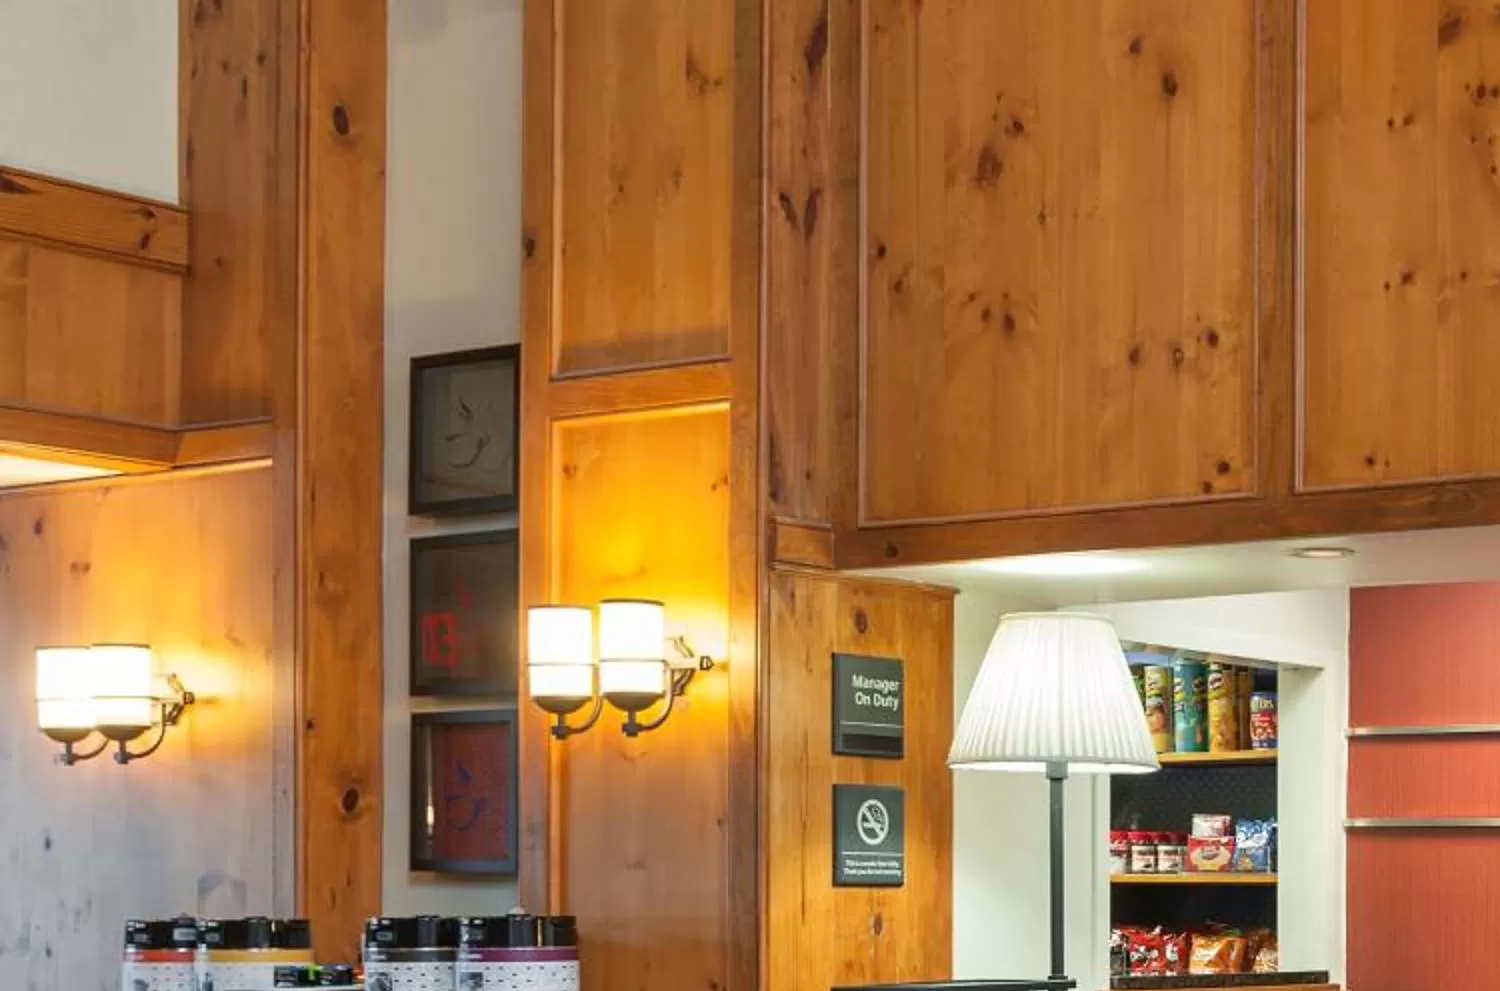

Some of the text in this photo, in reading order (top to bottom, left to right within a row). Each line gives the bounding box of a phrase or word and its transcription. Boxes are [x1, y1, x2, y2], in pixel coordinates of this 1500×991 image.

[852, 673, 900, 694] Manager
[855, 691, 900, 712] On Duty
